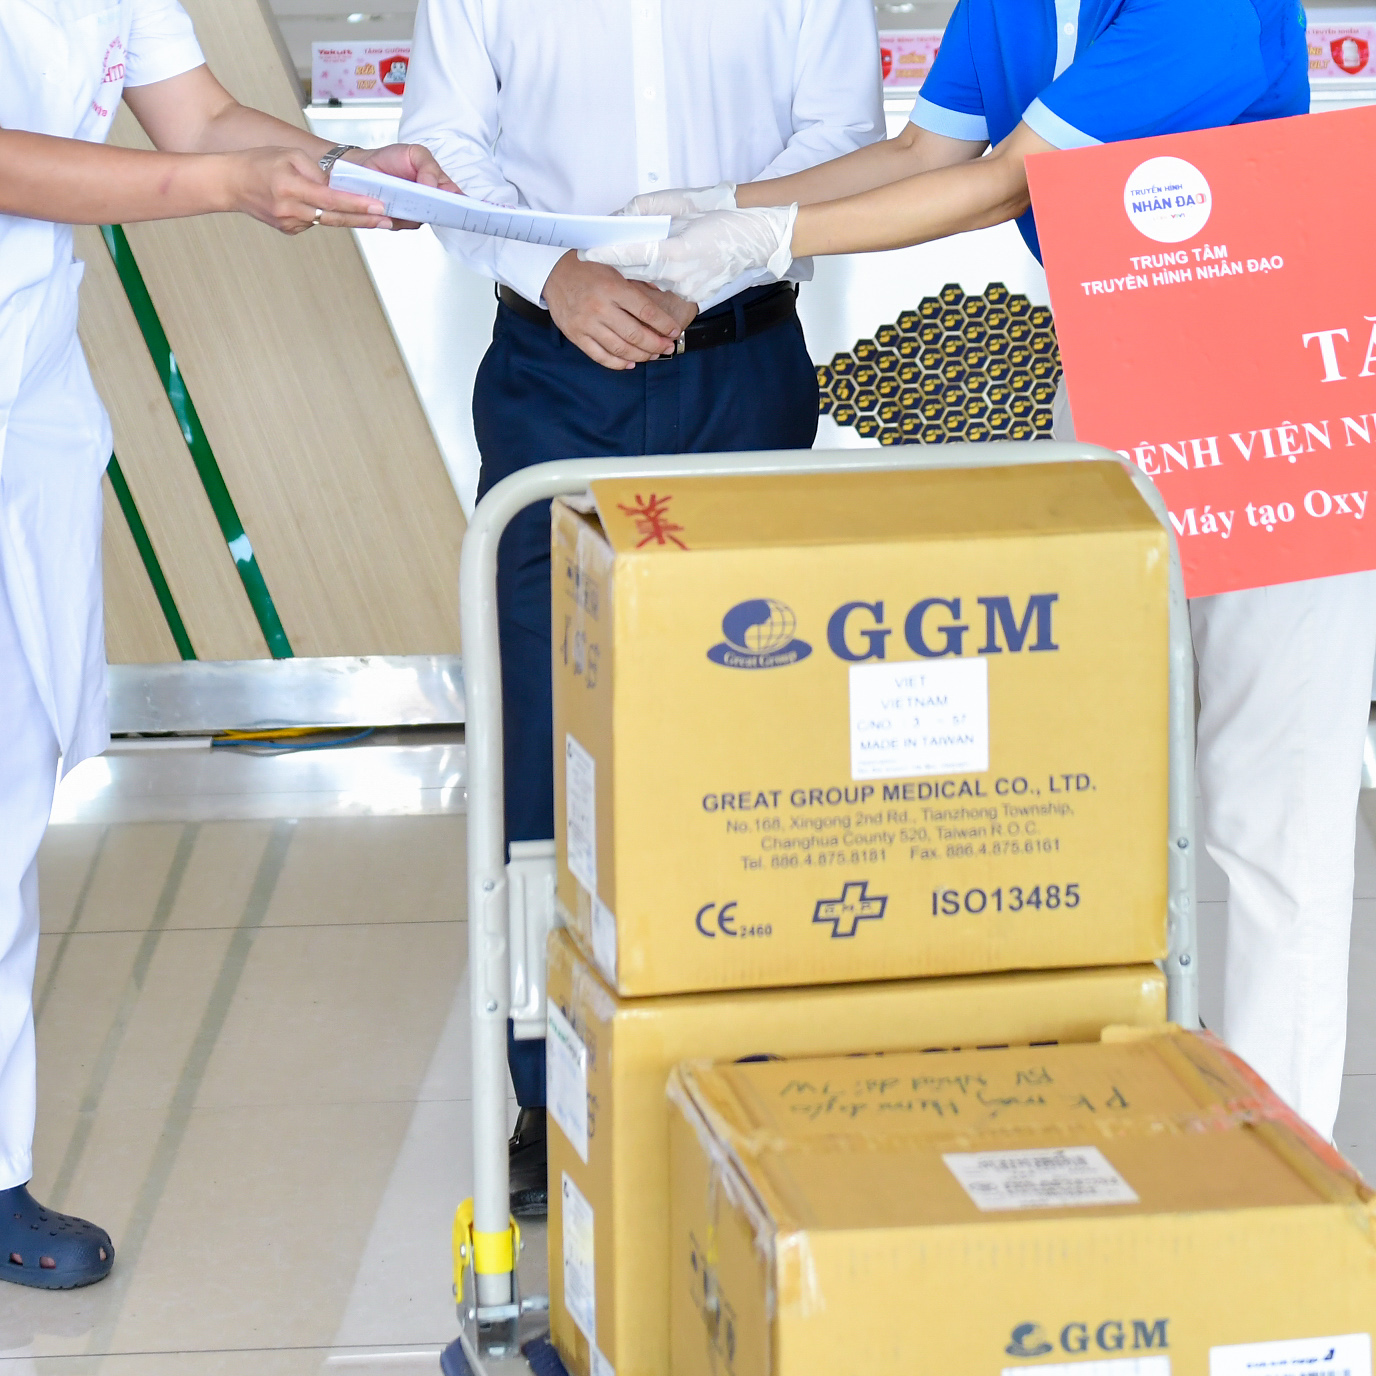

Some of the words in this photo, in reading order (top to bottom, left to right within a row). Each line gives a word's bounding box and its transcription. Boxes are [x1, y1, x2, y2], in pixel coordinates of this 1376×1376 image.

[1132, 196, 1173, 213] NHÂN
[1175, 192, 1207, 208] ĐẠO
[1130, 250, 1189, 271] TRUNG
[1191, 244, 1228, 262] TÂM
[1081, 274, 1148, 295] TRUYỀN
[1152, 268, 1193, 286] HÌNH
[1195, 260, 1244, 280] NHÂN
[1246, 255, 1284, 274] ĐẠO
[1228, 420, 1332, 464] VIỆN
[1168, 505, 1235, 539] Máy
[1245, 501, 1295, 532] tạo
[1303, 489, 1369, 520] Oxy
[826, 593, 1059, 663] GGM
[903, 737, 918, 748] IN
[702, 790, 782, 813] GREAT
[790, 785, 874, 808] GROUP
[882, 779, 988, 802] MEDICAL
[995, 776, 1042, 797] CO.,
[1049, 773, 1097, 793] LTD.
[855, 811, 882, 827] 2nd
[761, 834, 839, 851] Changhua
[843, 830, 895, 847] County
[937, 825, 987, 841] Taiwan
[931, 883, 1081, 916] ISO13485
[1059, 1319, 1170, 1355] GGM
